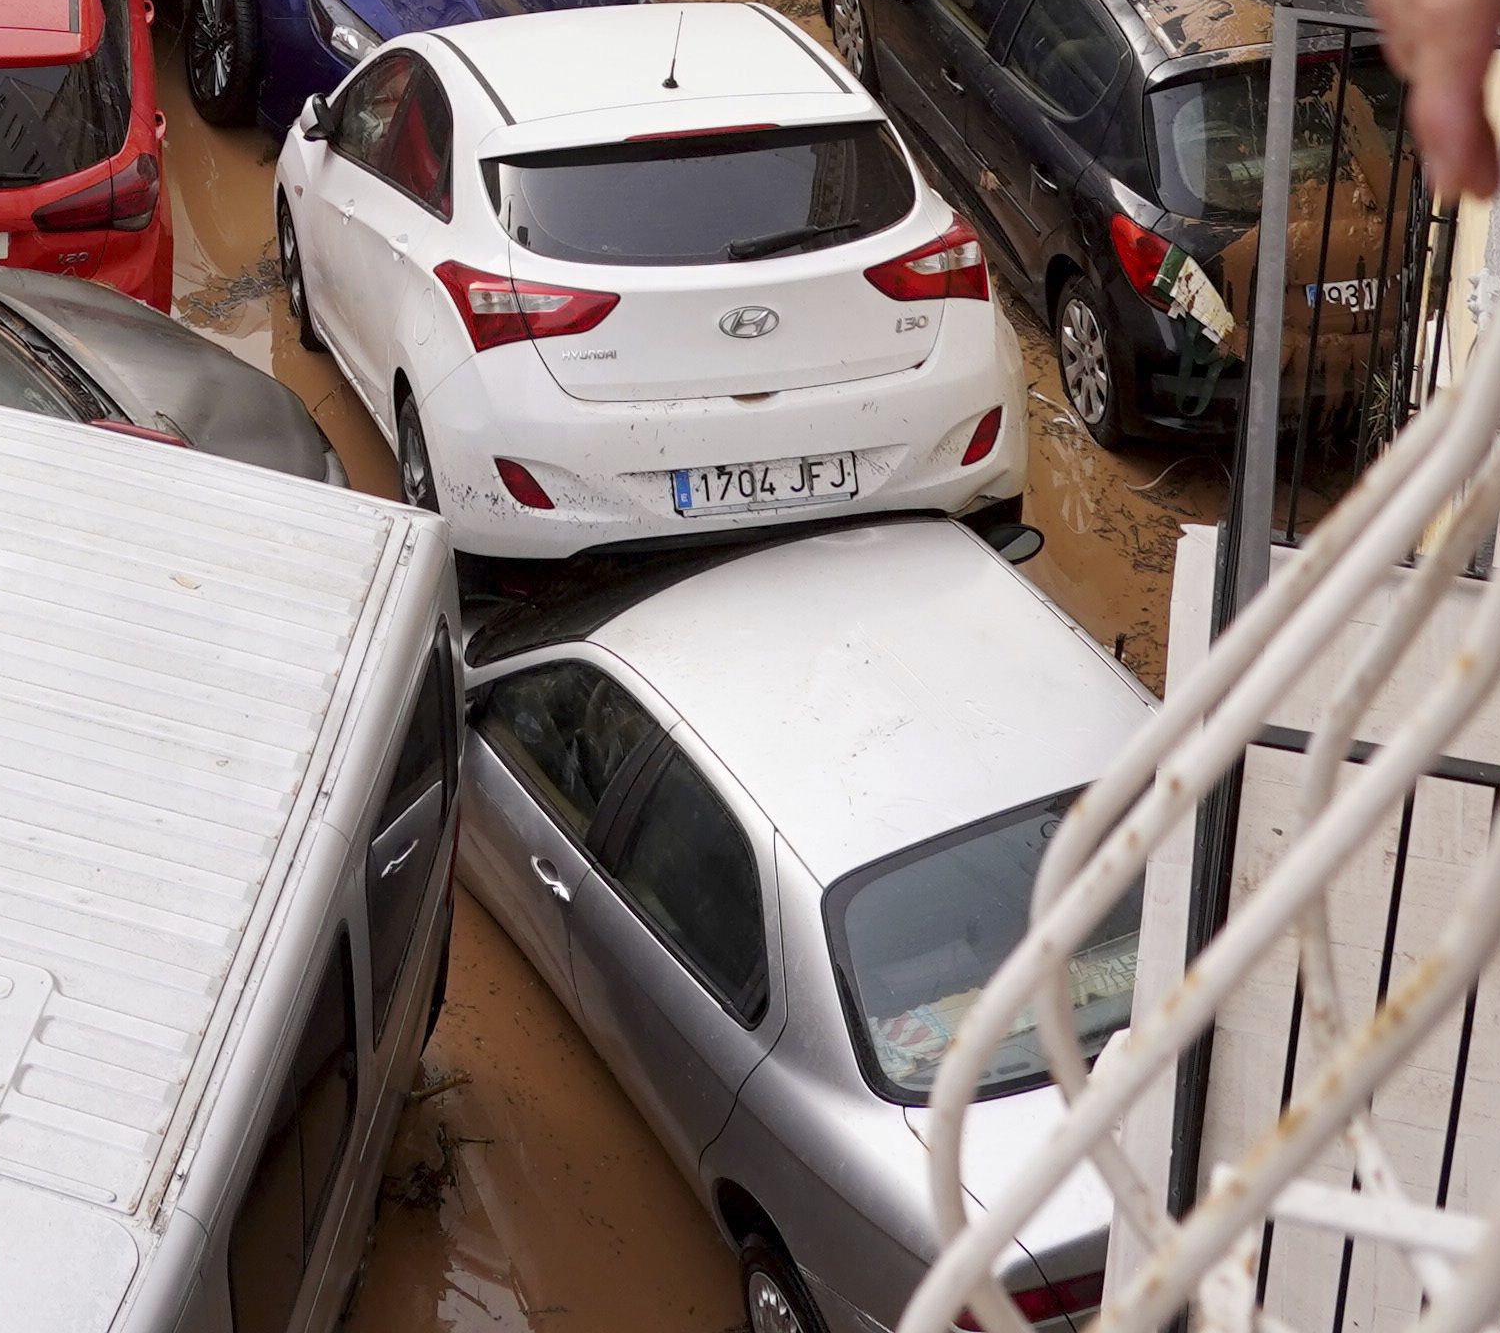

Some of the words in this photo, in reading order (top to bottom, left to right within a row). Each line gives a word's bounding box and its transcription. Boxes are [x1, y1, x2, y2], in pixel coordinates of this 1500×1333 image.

[562, 350, 617, 361] HYUNDAI
[697, 461, 775, 503] 1704
[786, 454, 846, 494] JFJ
